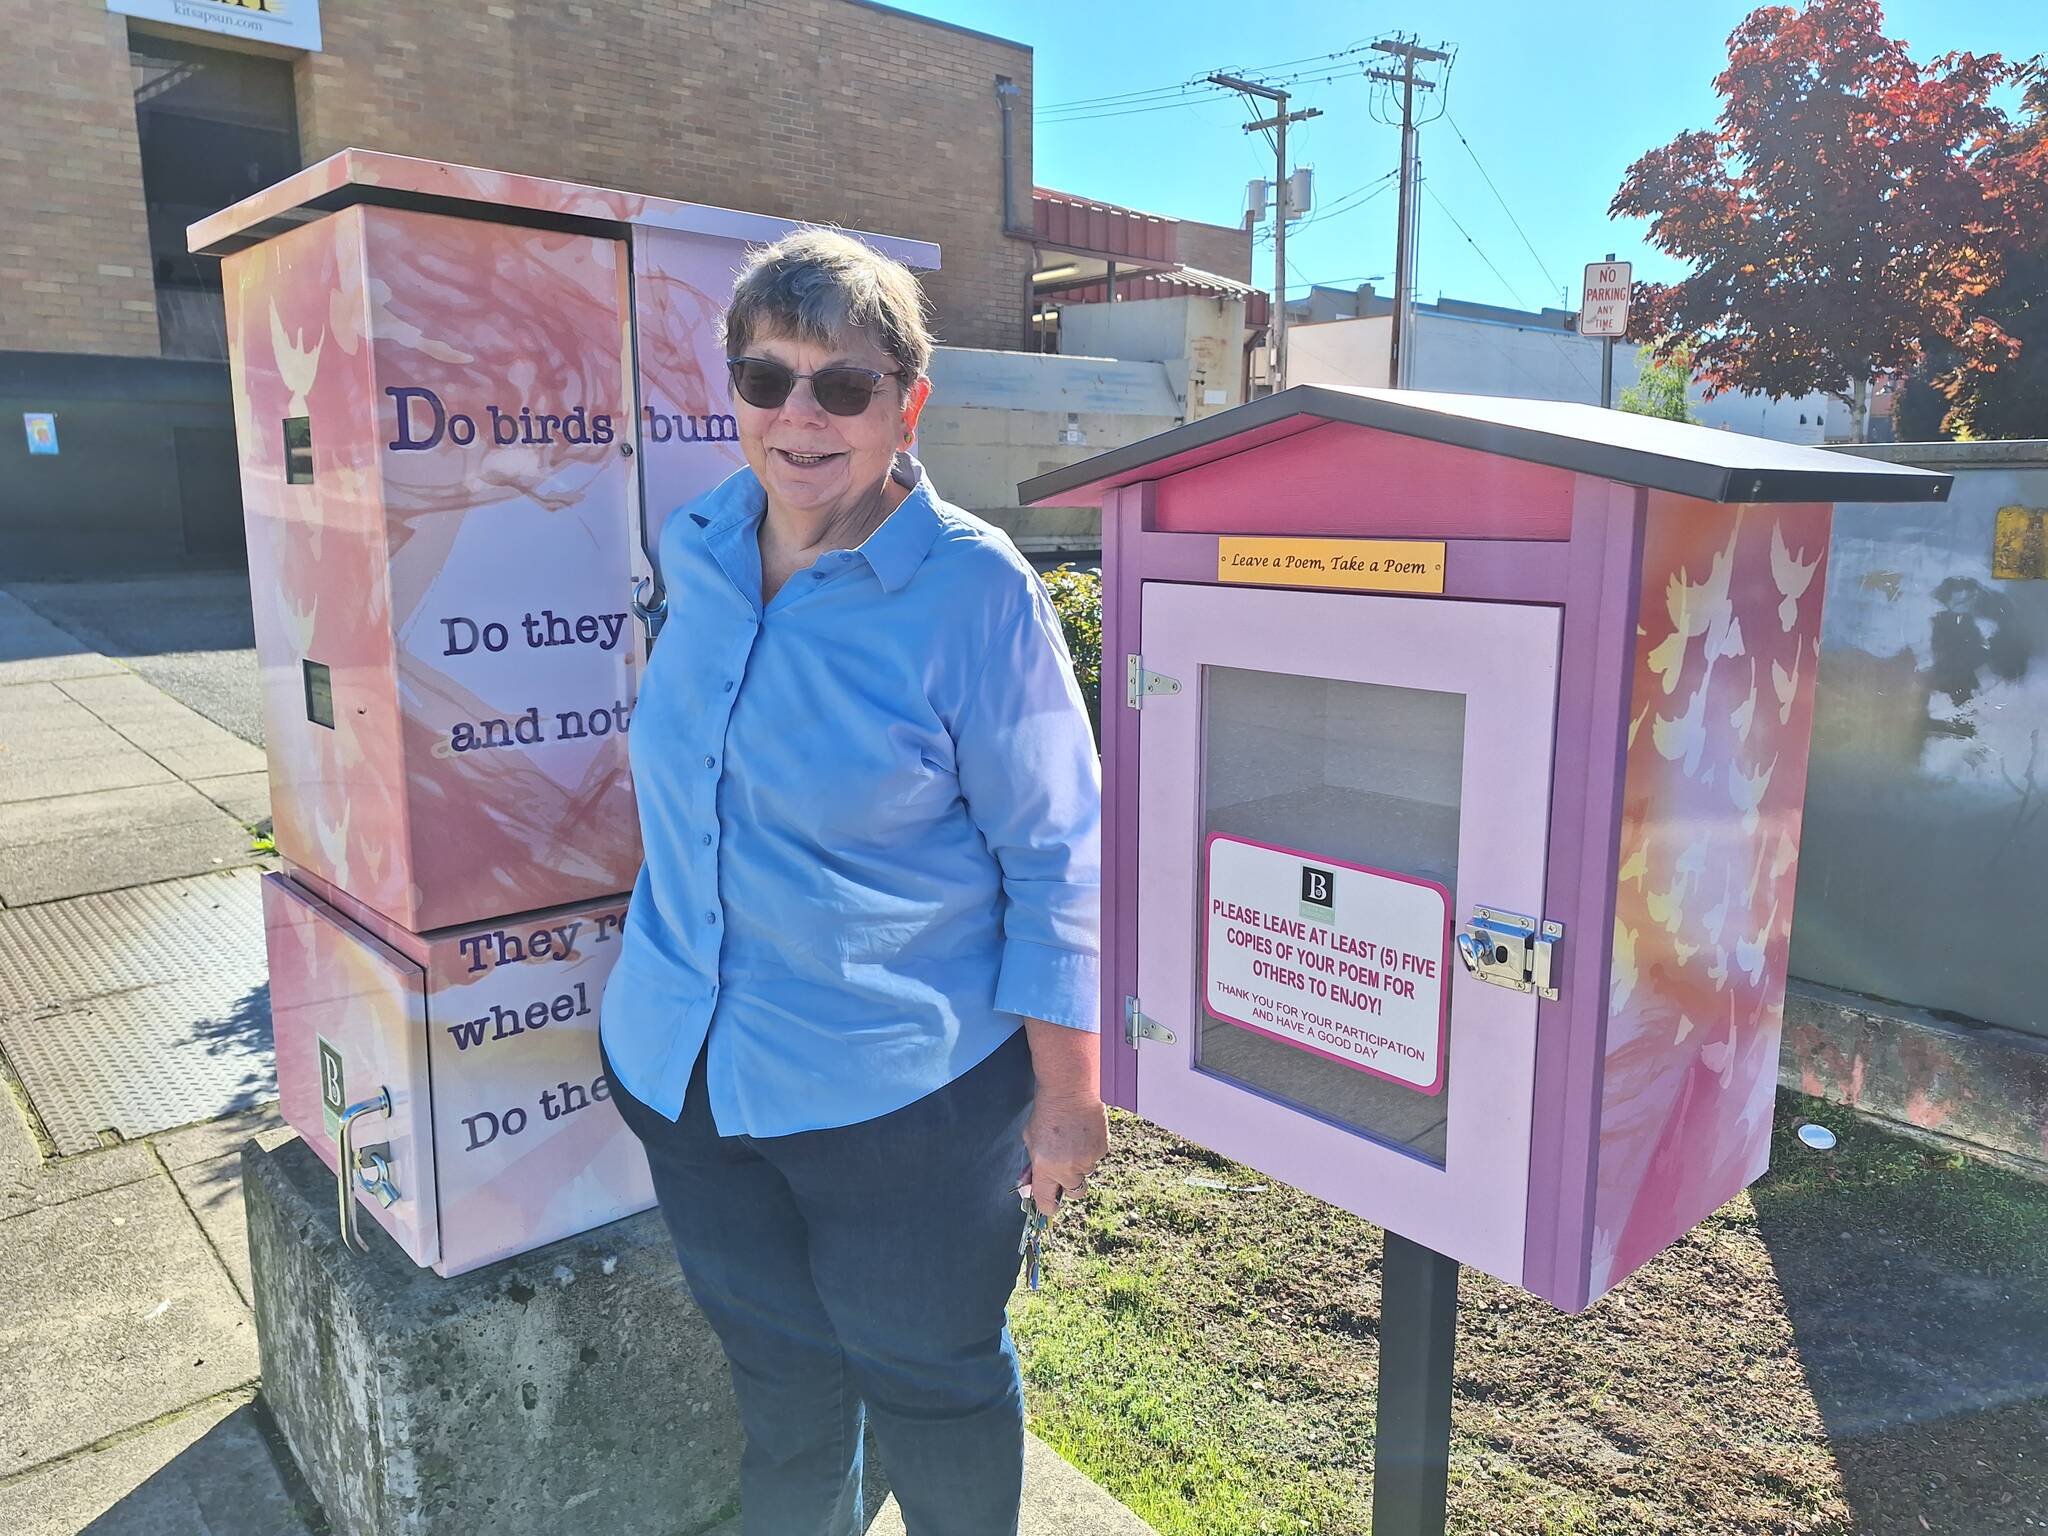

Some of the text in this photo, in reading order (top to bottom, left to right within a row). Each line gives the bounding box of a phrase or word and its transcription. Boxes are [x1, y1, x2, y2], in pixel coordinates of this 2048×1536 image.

[173, 1, 263, 31] kitsapsun.com
[1586, 287, 1627, 302] PARKING
[1599, 268, 1617, 283] NO
[1595, 319, 1613, 328] TIME
[1596, 305, 1615, 315] ANY
[384, 386, 476, 451] Do
[486, 405, 614, 445] birds
[1231, 553, 1426, 574] Leave a Poem, Take a Poem
[440, 610, 628, 656] Do they
[450, 707, 544, 751] and
[1308, 871, 1327, 901] B
[460, 922, 582, 973] They
[1213, 898, 1436, 979] PLEASE LEAVE AT LEAST (5) FIVE
[1227, 927, 1415, 1000] COPIES OF YOUR POEM FOR
[1253, 959, 1382, 1016] OTHERS TO ENJOY!
[447, 982, 592, 1051] wheel
[1216, 980, 1425, 1062] THANK YOU FOR YOUR PARTICIPATION
[1252, 1007, 1379, 1060] AND HAVE A GOOD DAY
[323, 1051, 342, 1106] B
[461, 1107, 527, 1152] Do
